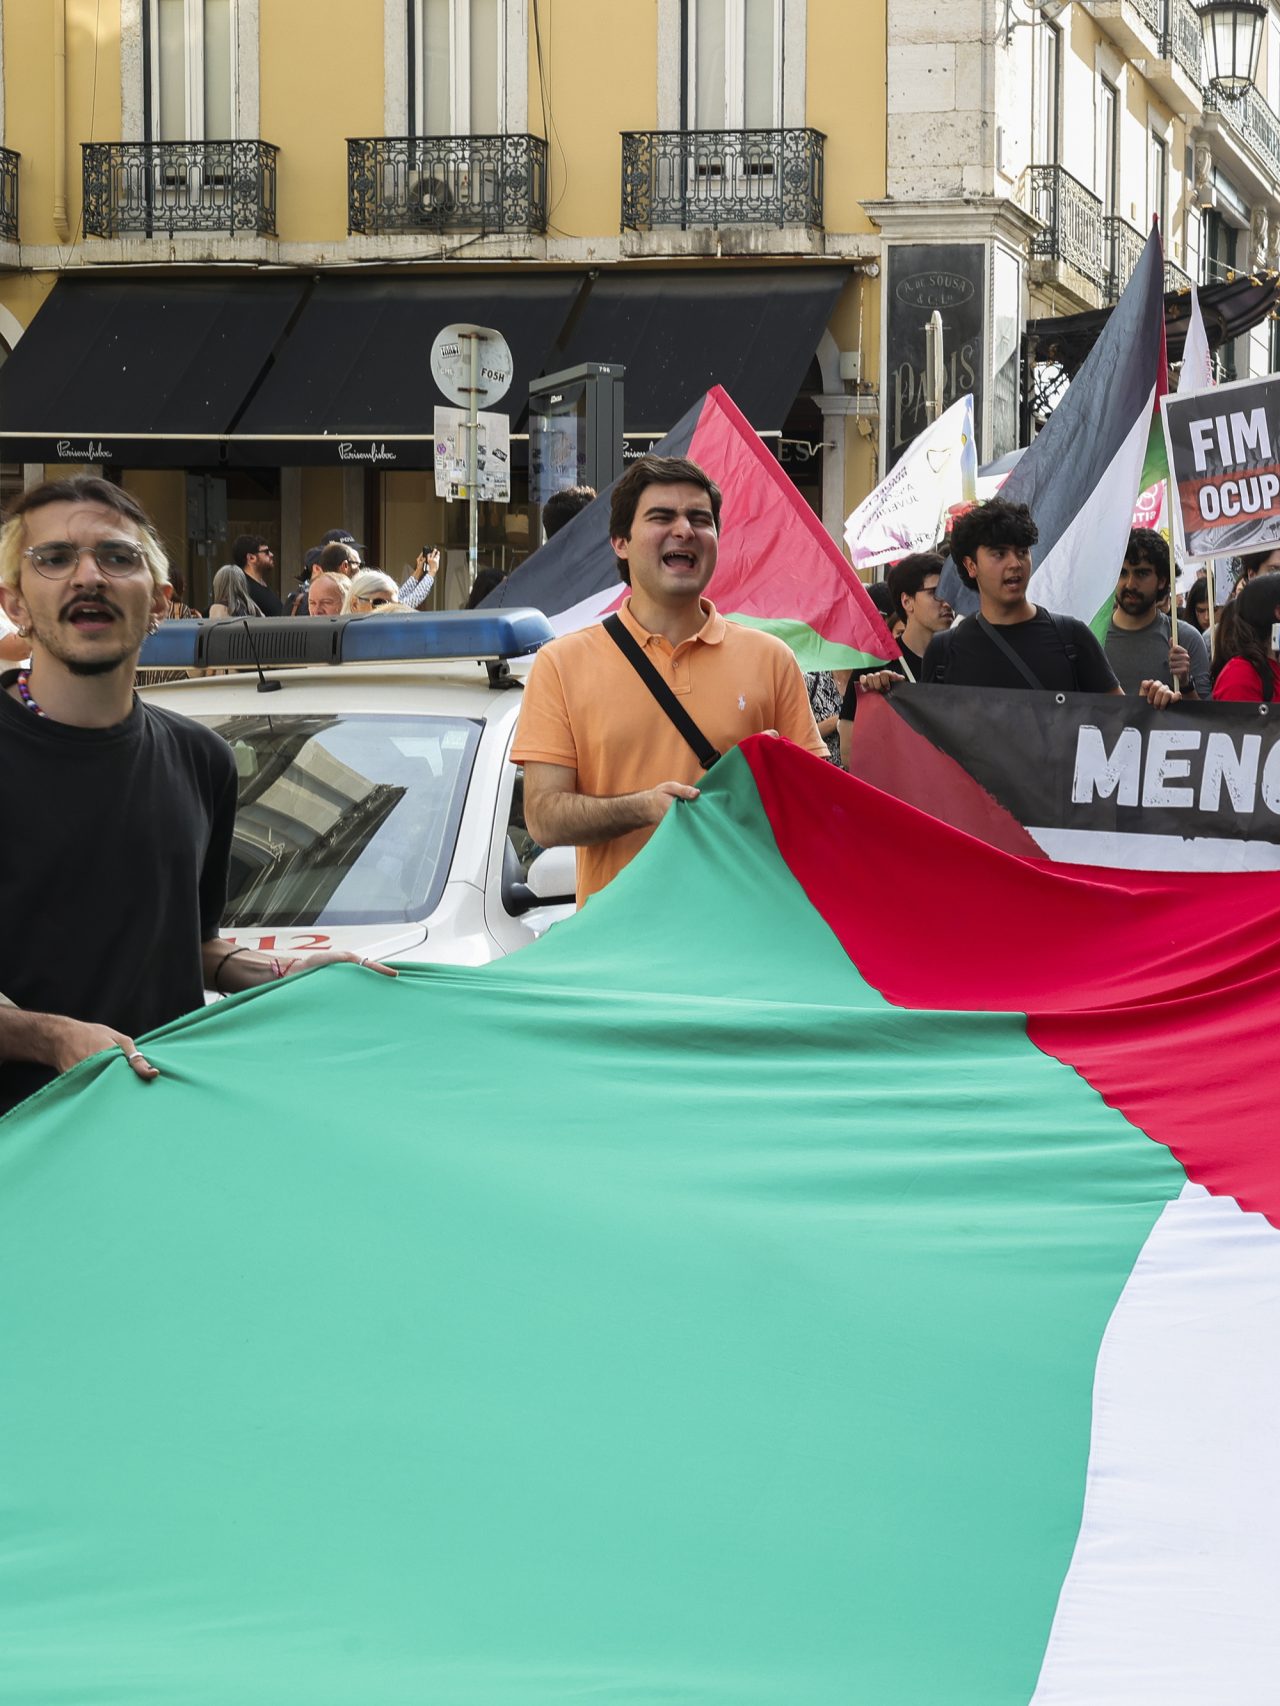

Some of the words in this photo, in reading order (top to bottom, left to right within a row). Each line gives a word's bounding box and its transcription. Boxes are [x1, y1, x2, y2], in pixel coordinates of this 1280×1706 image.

[929, 275, 966, 293] SOUSA
[892, 344, 975, 449] PAIS
[778, 439, 810, 461] ES
[1189, 407, 1272, 472] FIM
